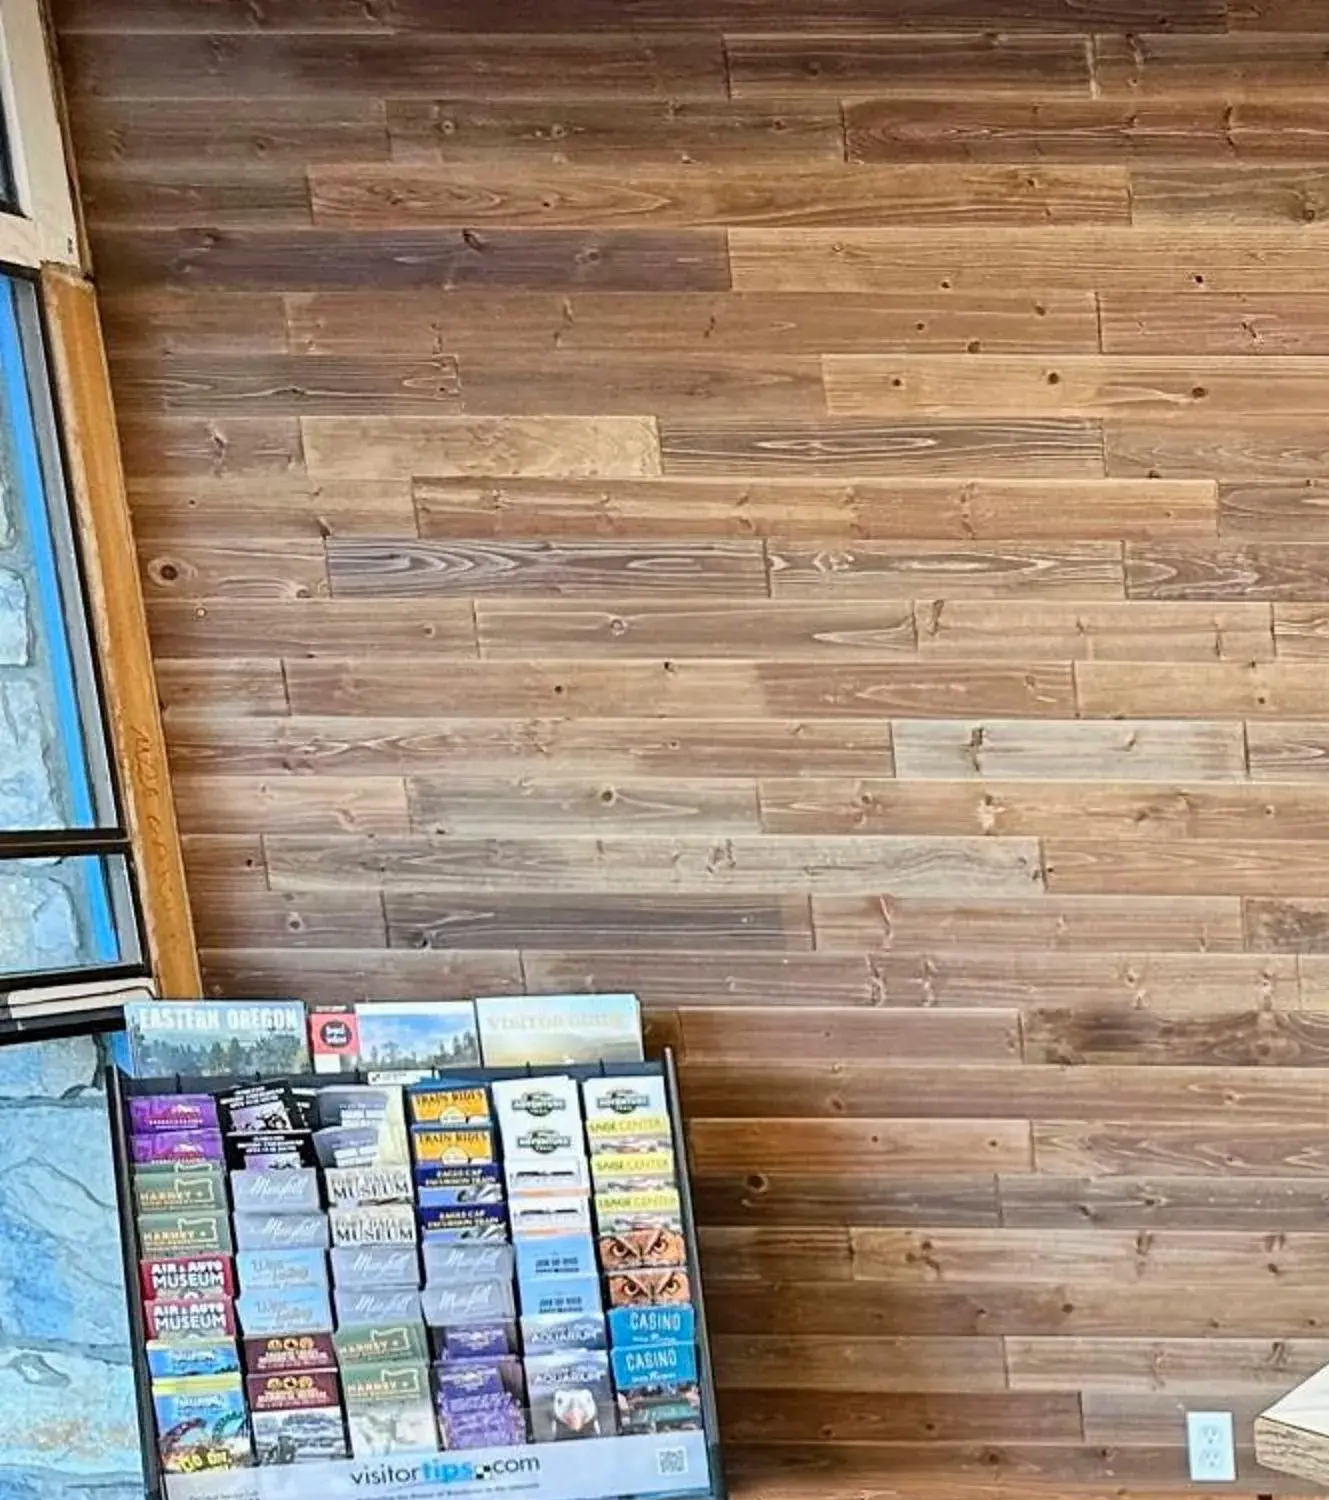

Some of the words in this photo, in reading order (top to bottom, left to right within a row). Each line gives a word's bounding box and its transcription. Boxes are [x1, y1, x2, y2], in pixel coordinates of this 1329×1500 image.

[139, 1007, 220, 1031] EASTERN
[227, 1007, 299, 1030] OREGON
[333, 1182, 409, 1200] MUSEUM
[336, 1228, 413, 1242] MUSEUM
[152, 1262, 180, 1274] AIR
[152, 1271, 224, 1289] MUSEUM
[154, 1304, 181, 1316] AIR
[154, 1312, 226, 1331] MUSEUM
[629, 1311, 681, 1333] CASINO
[625, 1349, 677, 1370] CASINO
